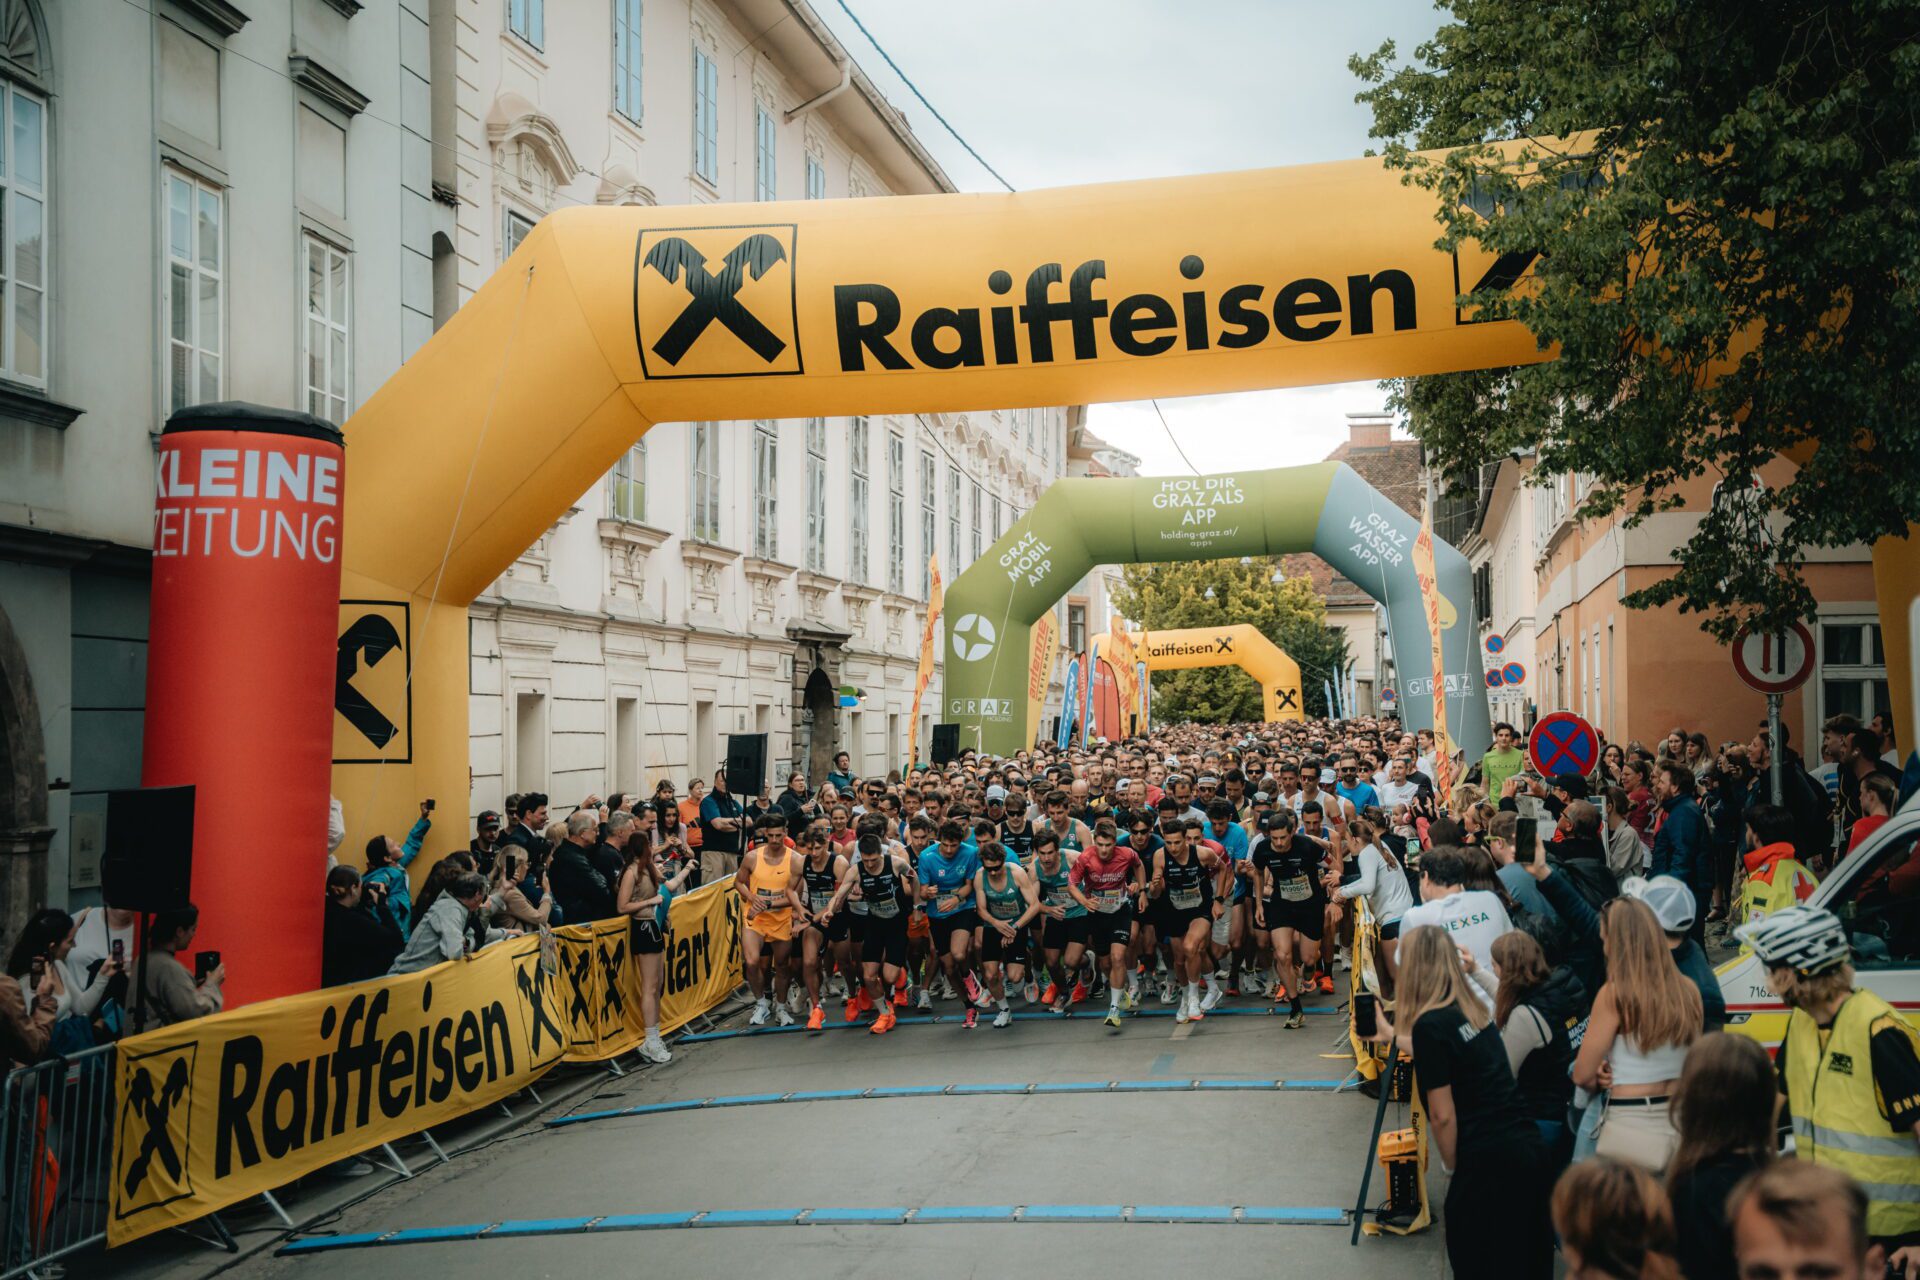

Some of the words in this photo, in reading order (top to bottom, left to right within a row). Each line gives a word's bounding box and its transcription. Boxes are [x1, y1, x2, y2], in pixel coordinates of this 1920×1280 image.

[834, 254, 1418, 372] Raiffeisen
[157, 449, 338, 506] KLEINE
[1161, 480, 1200, 492] HOL
[1206, 477, 1235, 490] DIR
[1152, 492, 1206, 508] GRAZ
[1211, 489, 1245, 505] ALS
[1181, 508, 1216, 525] APP
[1367, 513, 1408, 548] GRAZ
[1000, 531, 1037, 567] GRAZ
[1349, 516, 1403, 567] WASSER
[1349, 543, 1378, 565] APP
[1007, 541, 1051, 583] MOBIL
[1028, 559, 1051, 587] APP
[1029, 618, 1047, 700] antenne
[1409, 675, 1471, 694] GRAZ
[951, 699, 1010, 715] GRAZ
[660, 916, 712, 1000] tart
[1749, 985, 1779, 998] 7162
[214, 980, 515, 1180] Raiffeisen
